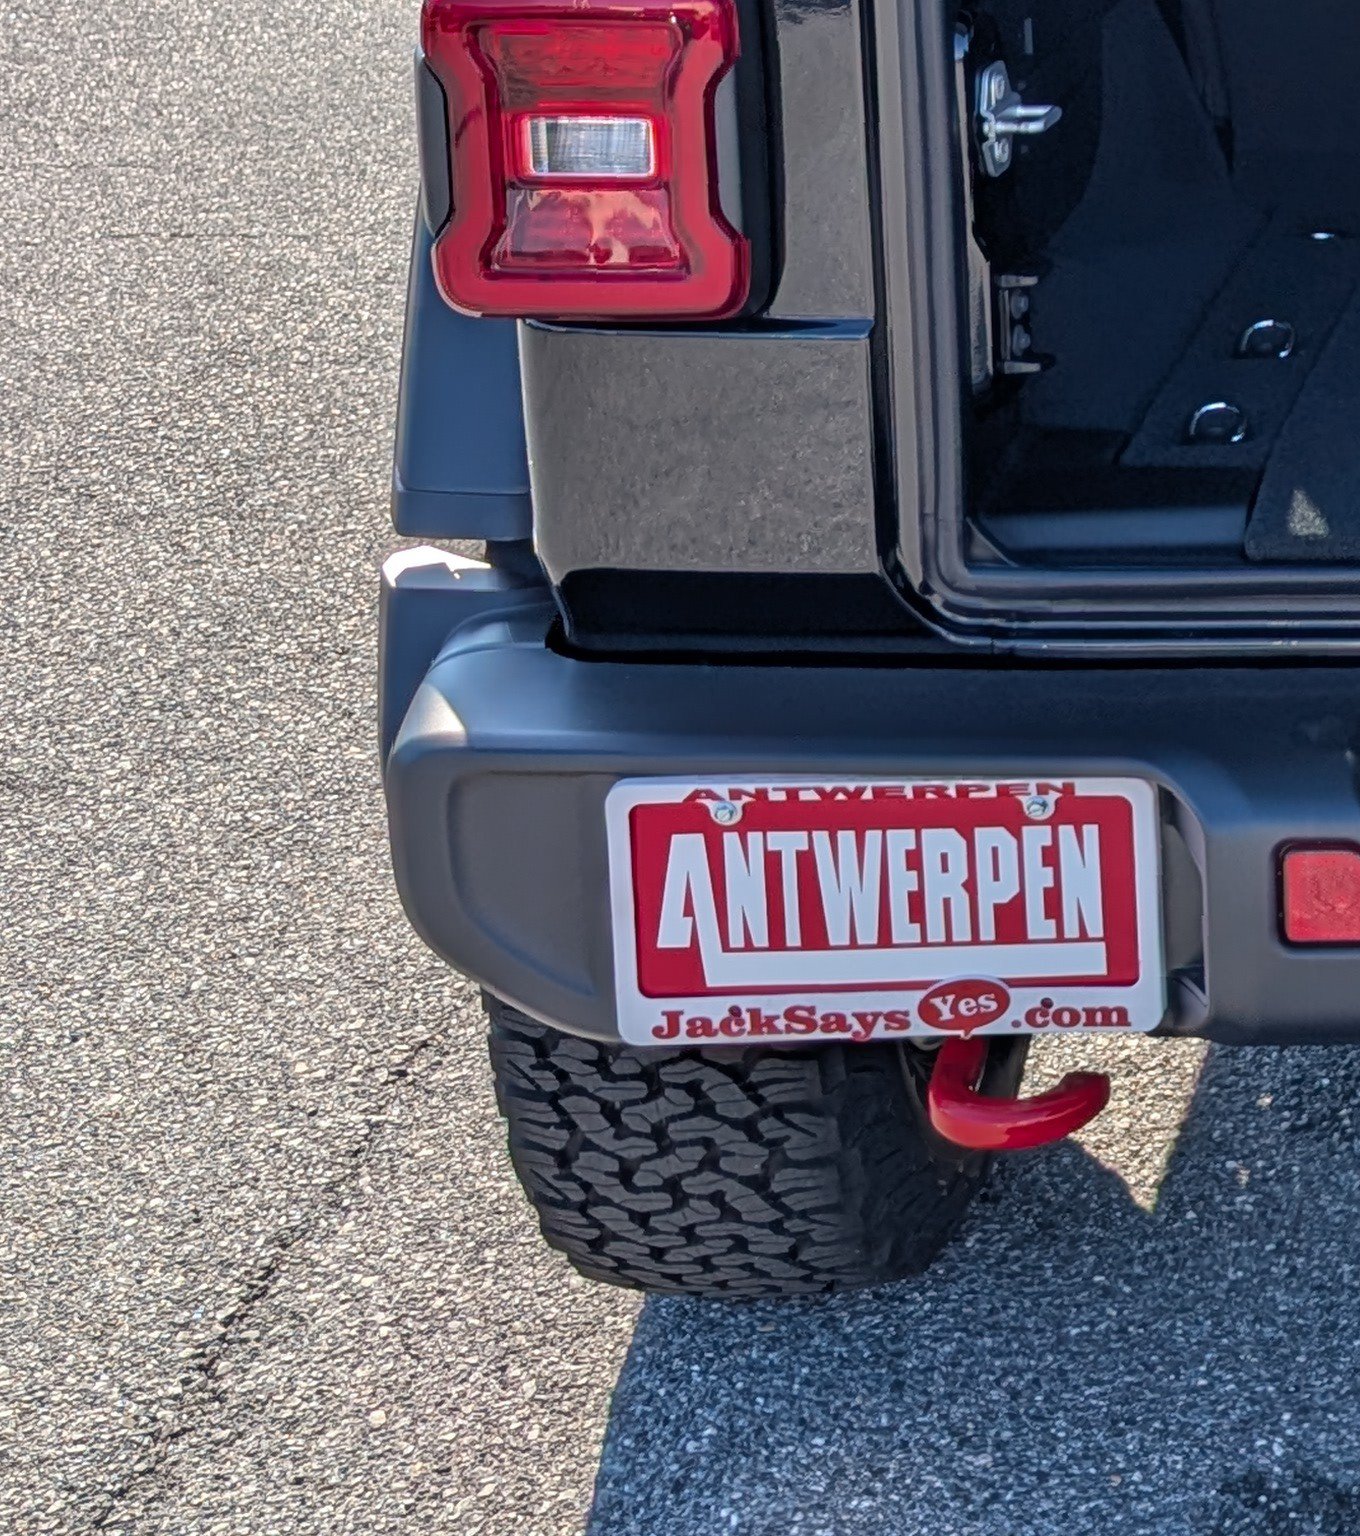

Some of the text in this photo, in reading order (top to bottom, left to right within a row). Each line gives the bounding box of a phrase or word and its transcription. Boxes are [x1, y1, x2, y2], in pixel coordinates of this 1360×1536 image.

[683, 781, 1076, 802] ANTWERPEN
[656, 823, 1105, 987] ANTWERPEN
[651, 1004, 911, 1042] JackSays
[929, 991, 1000, 1022] Yes
